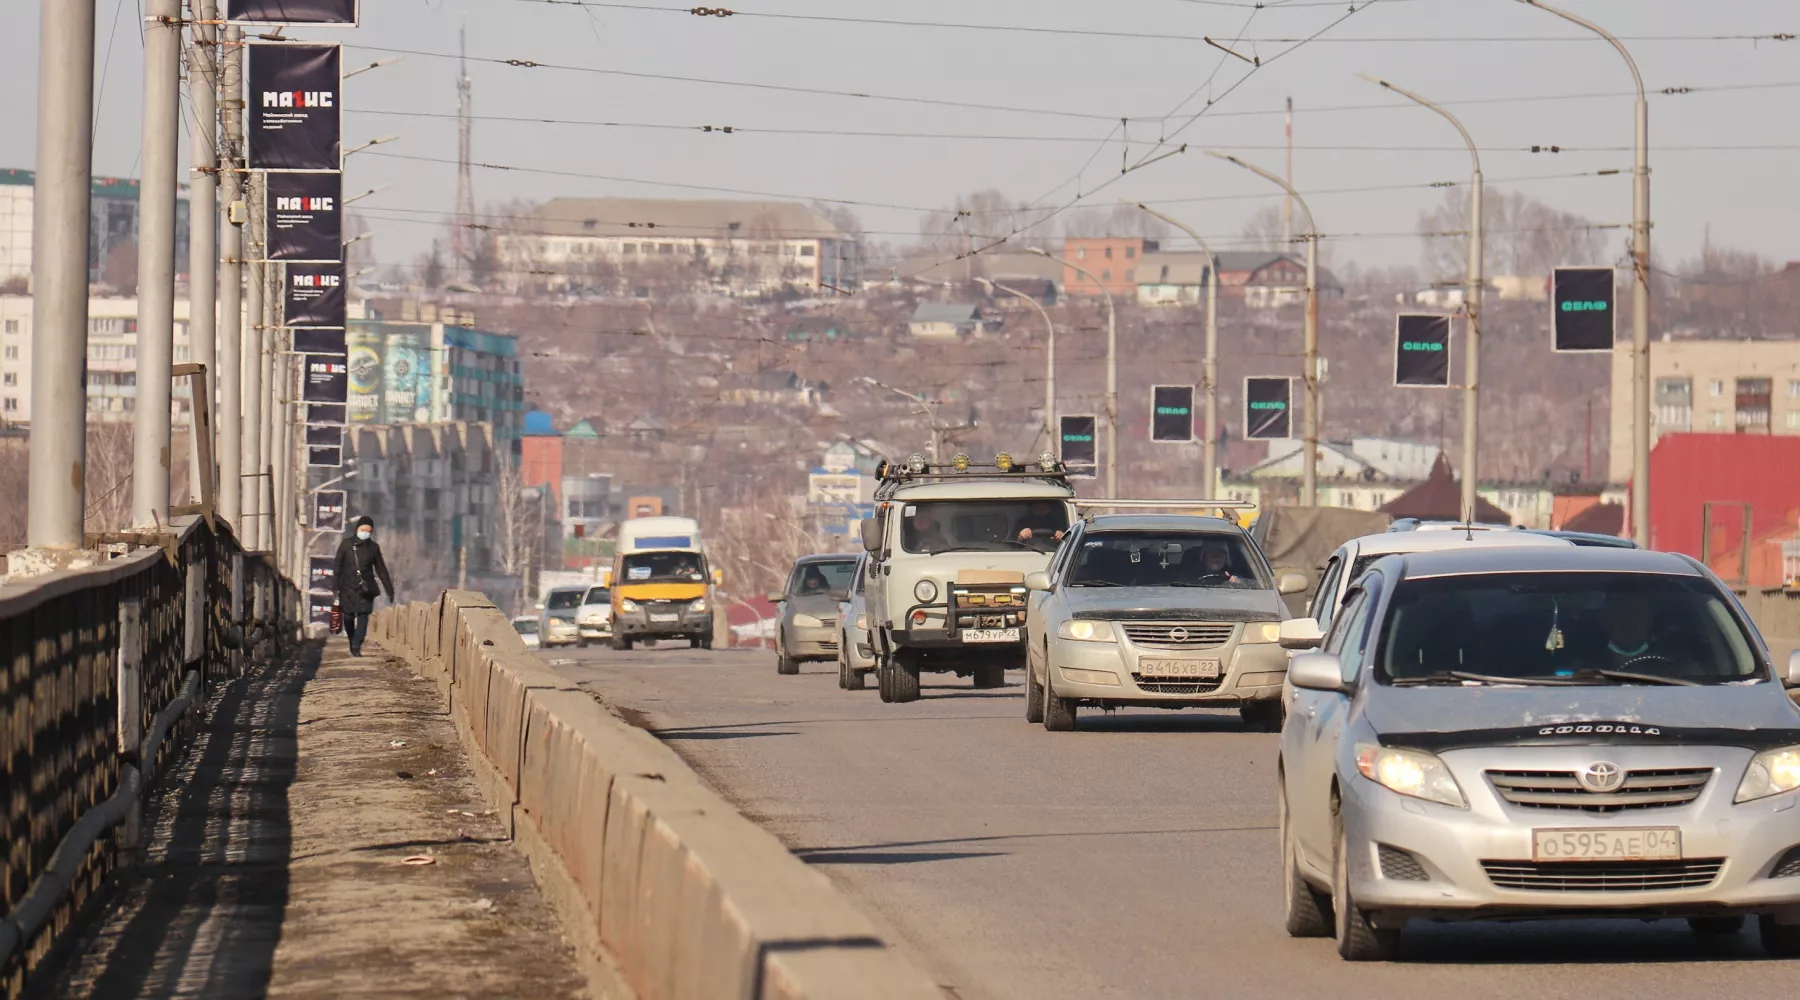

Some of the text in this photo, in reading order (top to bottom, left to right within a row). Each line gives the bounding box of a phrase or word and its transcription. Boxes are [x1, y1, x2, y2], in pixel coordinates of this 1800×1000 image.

[1561, 300, 1607, 311] СЕЛФ
[1402, 341, 1443, 351] СЕЛФ
[1201, 661, 1214, 672] 22
[1539, 725, 1660, 735] COROLLA
[1646, 830, 1670, 849] 04
